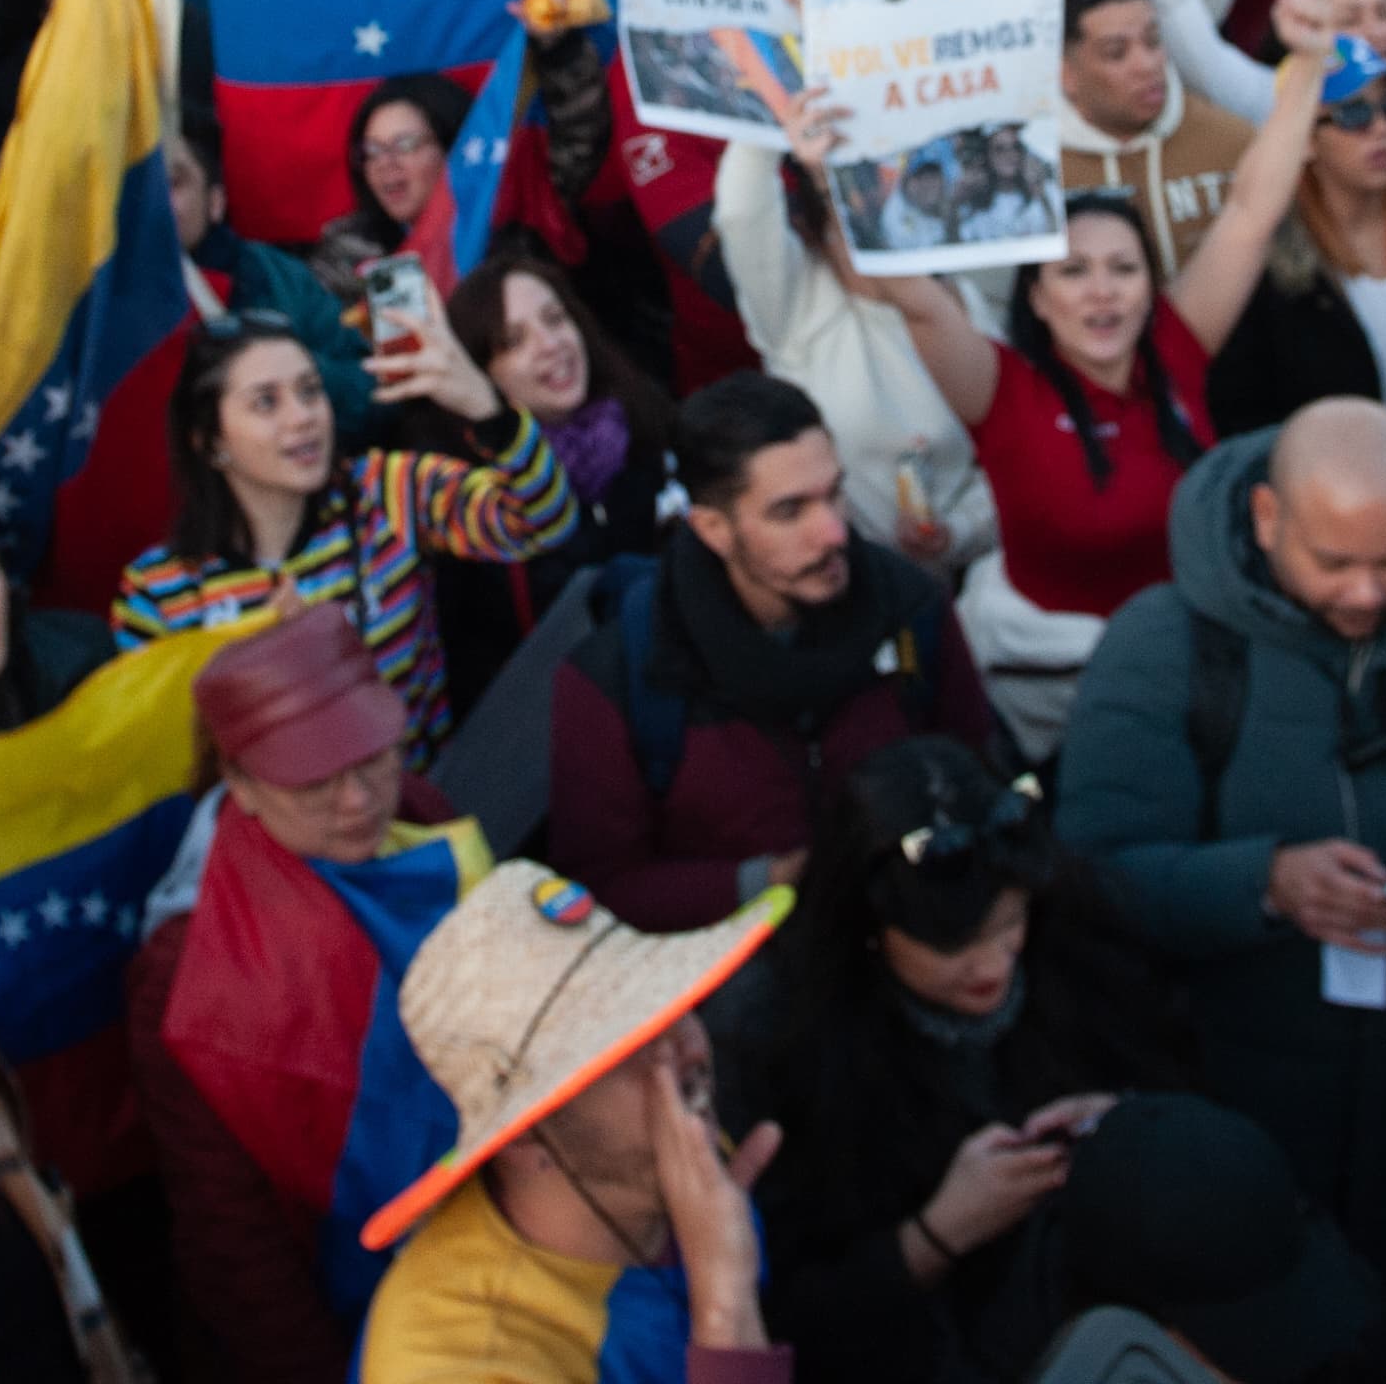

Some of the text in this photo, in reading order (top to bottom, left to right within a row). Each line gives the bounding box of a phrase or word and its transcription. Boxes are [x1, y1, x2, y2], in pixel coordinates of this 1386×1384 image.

[827, 18, 1035, 80] VOLVEREMOS
[884, 62, 1000, 111] A CASA
[1166, 170, 1238, 222] NT
